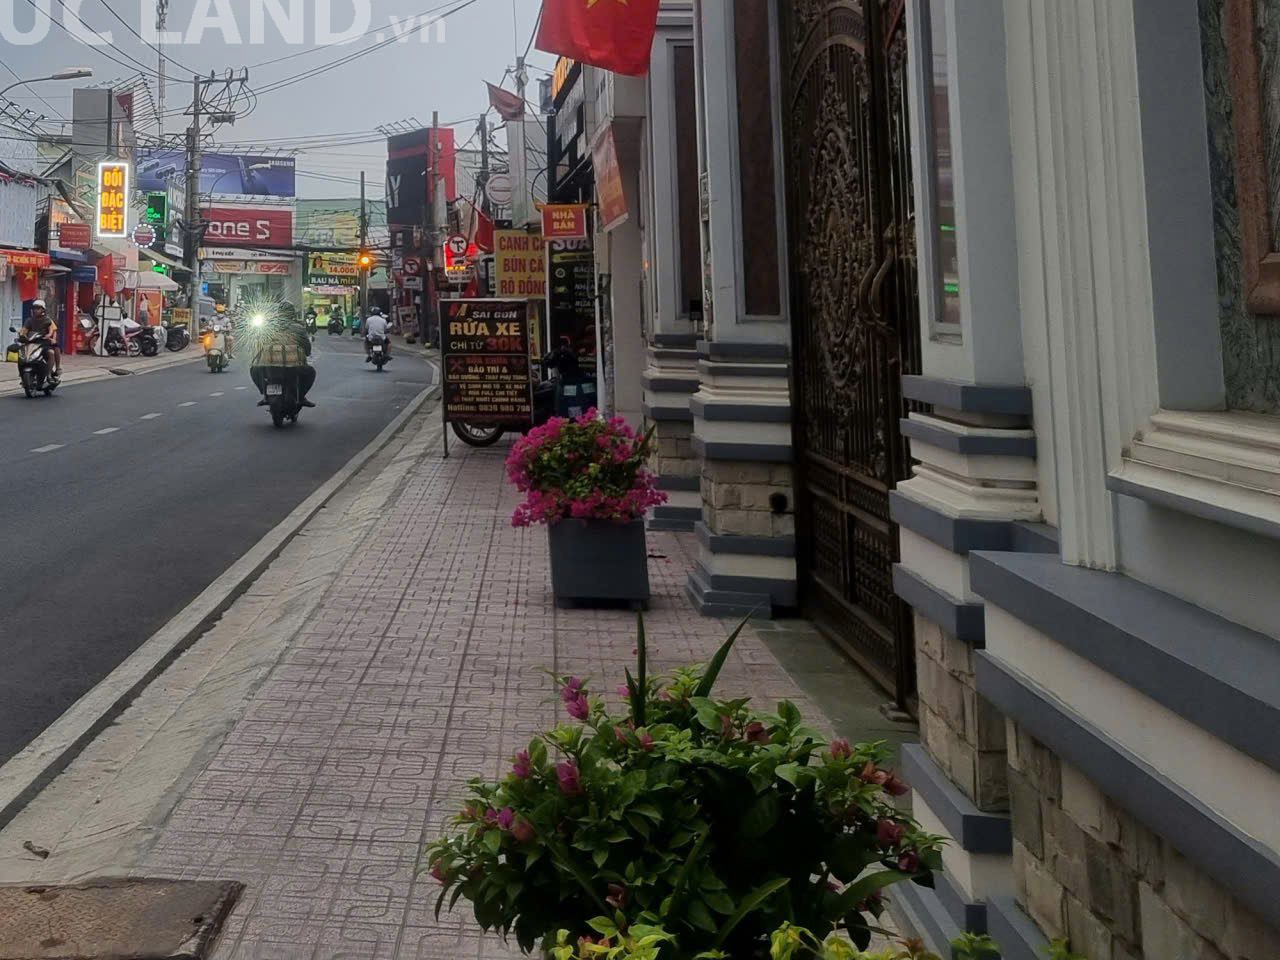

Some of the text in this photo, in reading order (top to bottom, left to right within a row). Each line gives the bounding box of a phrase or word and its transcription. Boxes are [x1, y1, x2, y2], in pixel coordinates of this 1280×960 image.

[101, 189, 124, 211] ĐẶC
[100, 211, 124, 233] BIỆT
[552, 209, 575, 219] NHÀ
[553, 219, 575, 230] BÁN
[500, 236, 529, 251] CANH
[504, 255, 526, 272] BÚN
[449, 318, 521, 336] RỬA XE
